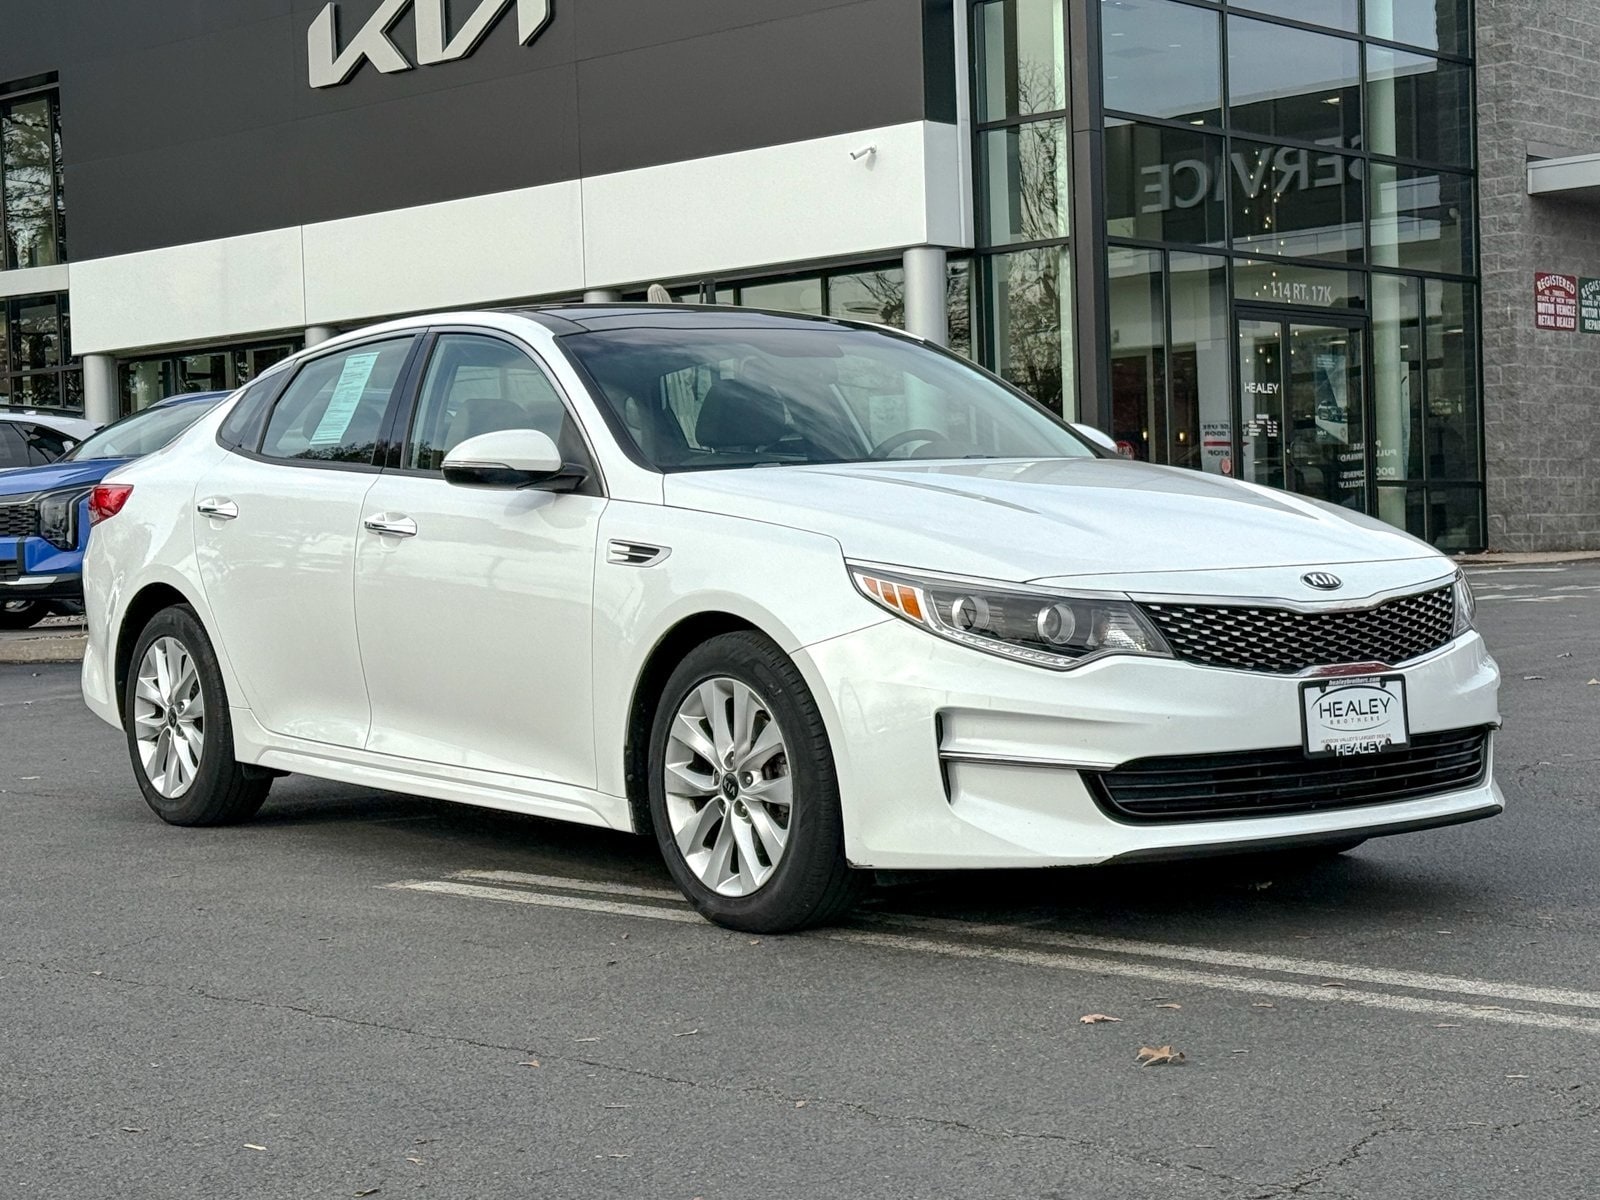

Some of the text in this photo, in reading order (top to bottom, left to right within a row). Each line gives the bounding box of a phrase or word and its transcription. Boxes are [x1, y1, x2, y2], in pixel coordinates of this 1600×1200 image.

[308, 0, 549, 88] KIA
[1537, 275, 1575, 294] REGISTERED
[1271, 282, 1331, 303] 114 RT. 17K
[1537, 302, 1575, 317] MOTOR VEHICLE
[1582, 307, 1598, 319] MOTOR
[1538, 315, 1574, 329] RETAIL DEALER
[1244, 382, 1279, 394] HEALEY
[1306, 574, 1340, 586] KIA
[1329, 677, 1380, 686] healeybrothers.com
[1320, 697, 1390, 719] HEALEY
[1330, 716, 1379, 725] BROTHERS
[1335, 741, 1382, 756] HEALEY
[724, 778, 735, 796] KIA
